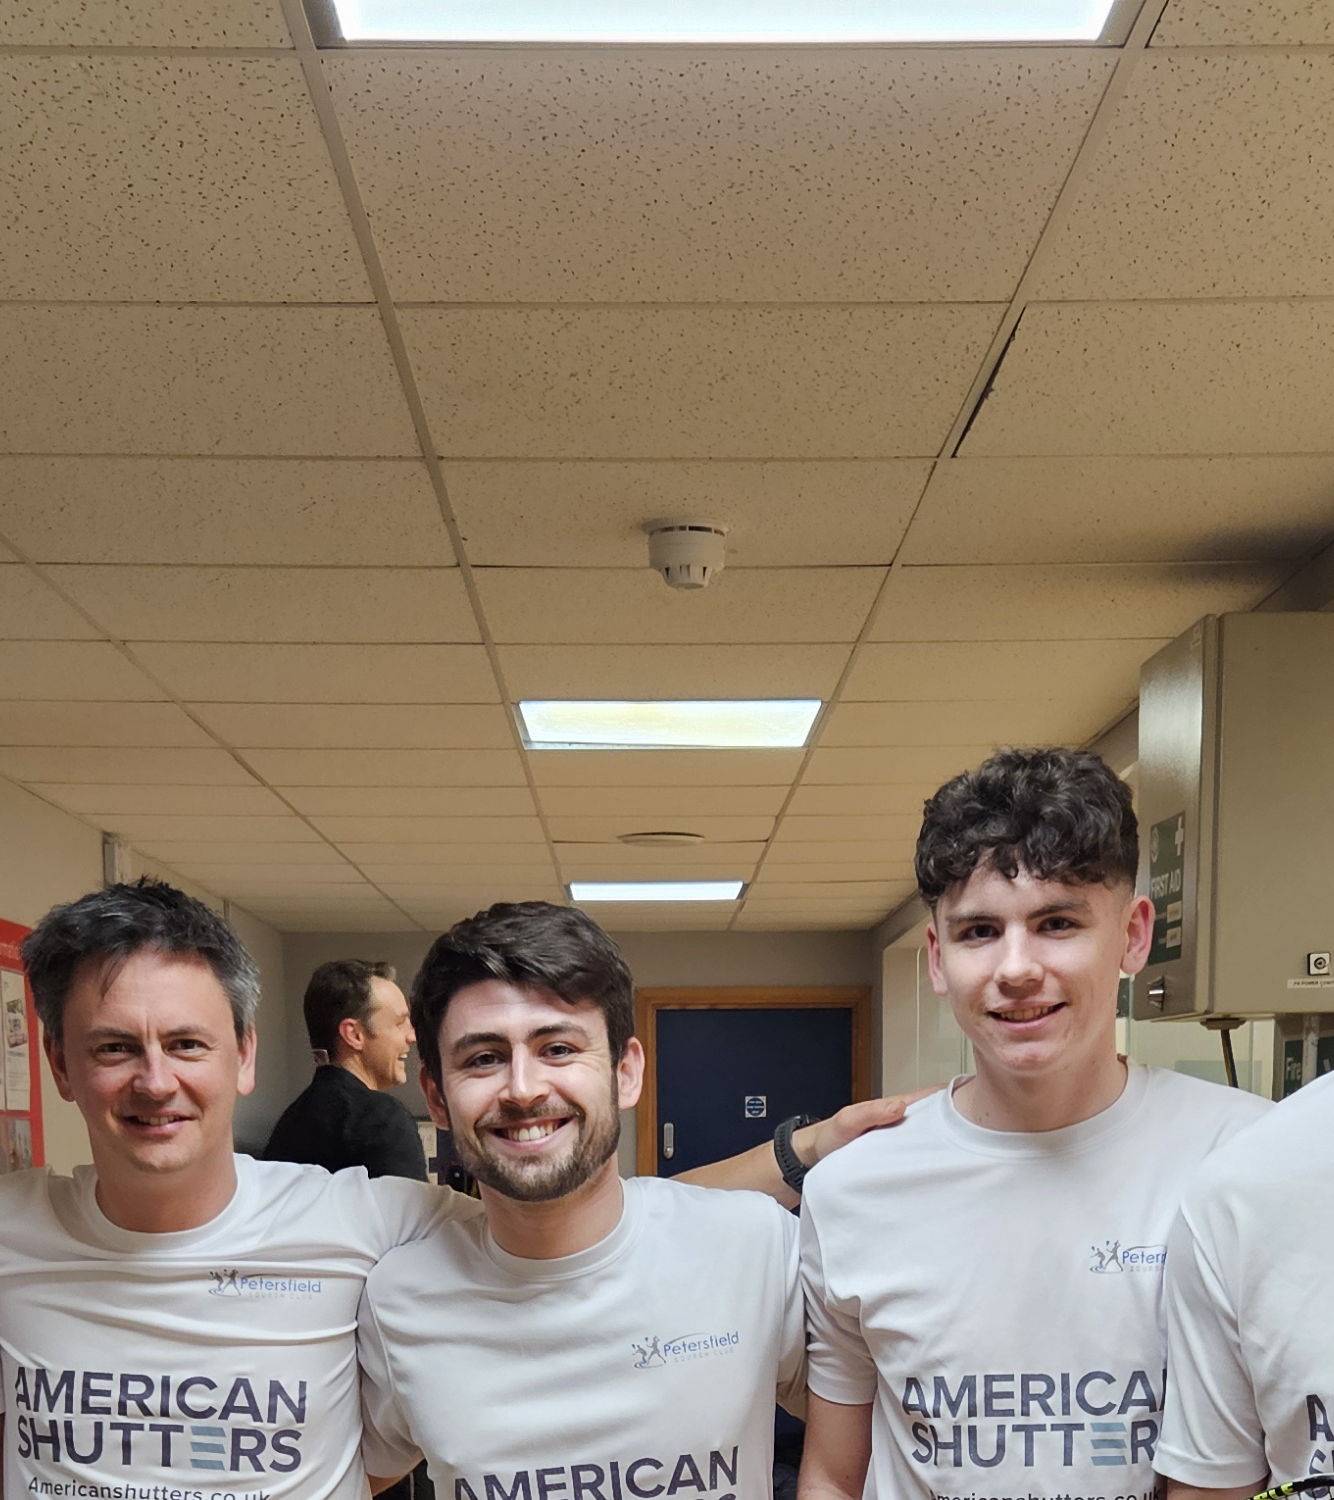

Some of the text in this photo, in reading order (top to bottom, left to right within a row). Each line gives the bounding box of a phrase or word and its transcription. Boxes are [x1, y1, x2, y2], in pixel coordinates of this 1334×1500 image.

[1151, 868, 1181, 899] FIRST AID
[1286, 1057, 1301, 1081] Fire
[240, 1277, 322, 1294] Petersfield
[663, 1331, 740, 1357] Petersfield
[14, 1365, 308, 1425] AMERICAN
[16, 1415, 303, 1474] SHUTTERS
[910, 1419, 1162, 1469] SHUTTER
